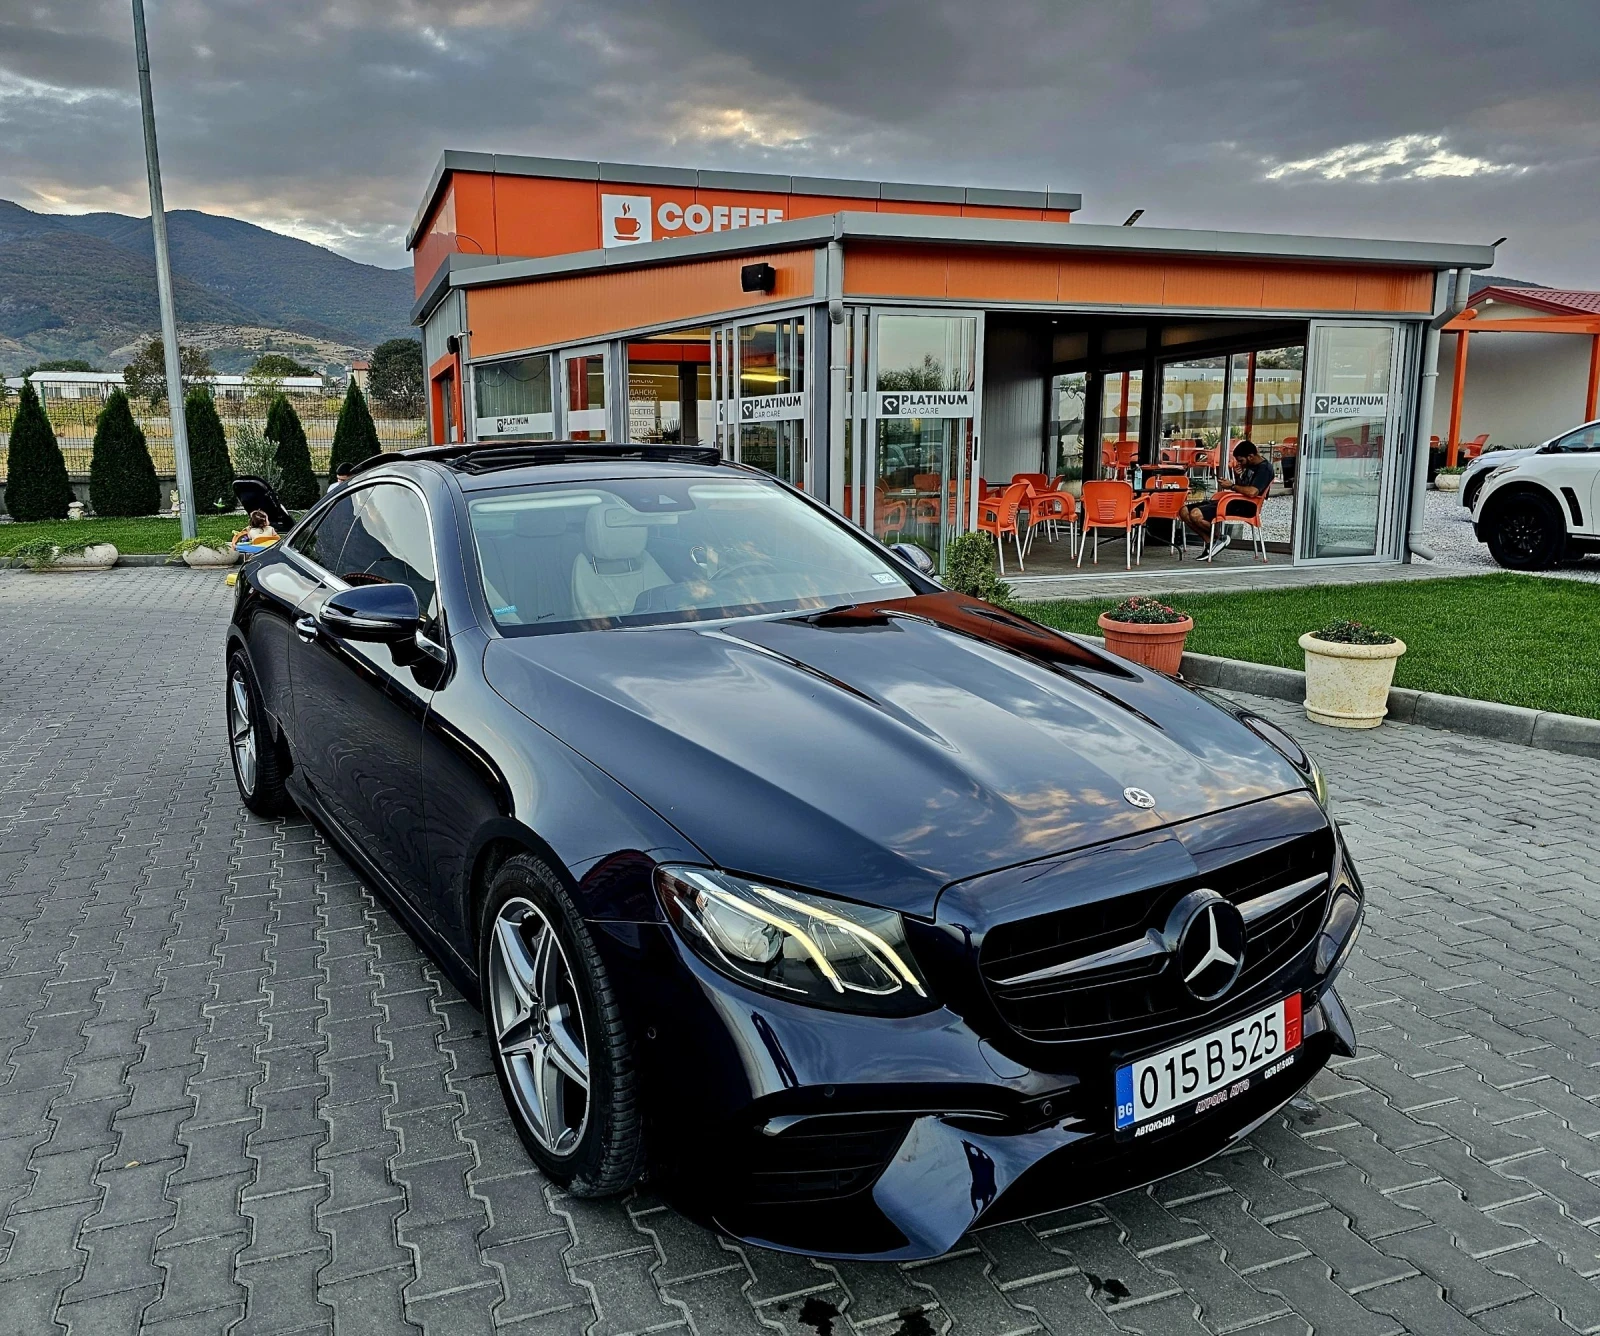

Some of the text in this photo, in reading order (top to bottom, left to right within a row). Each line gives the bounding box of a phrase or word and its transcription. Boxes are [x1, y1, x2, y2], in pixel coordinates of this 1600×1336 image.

[754, 396, 801, 410] PLATINUM
[901, 394, 968, 406] PLATINUM
[1330, 396, 1384, 406] PLATINUM
[754, 410, 781, 419] CAR CARE
[901, 407, 939, 415] CAR CARE
[1117, 1102, 1133, 1120] BG
